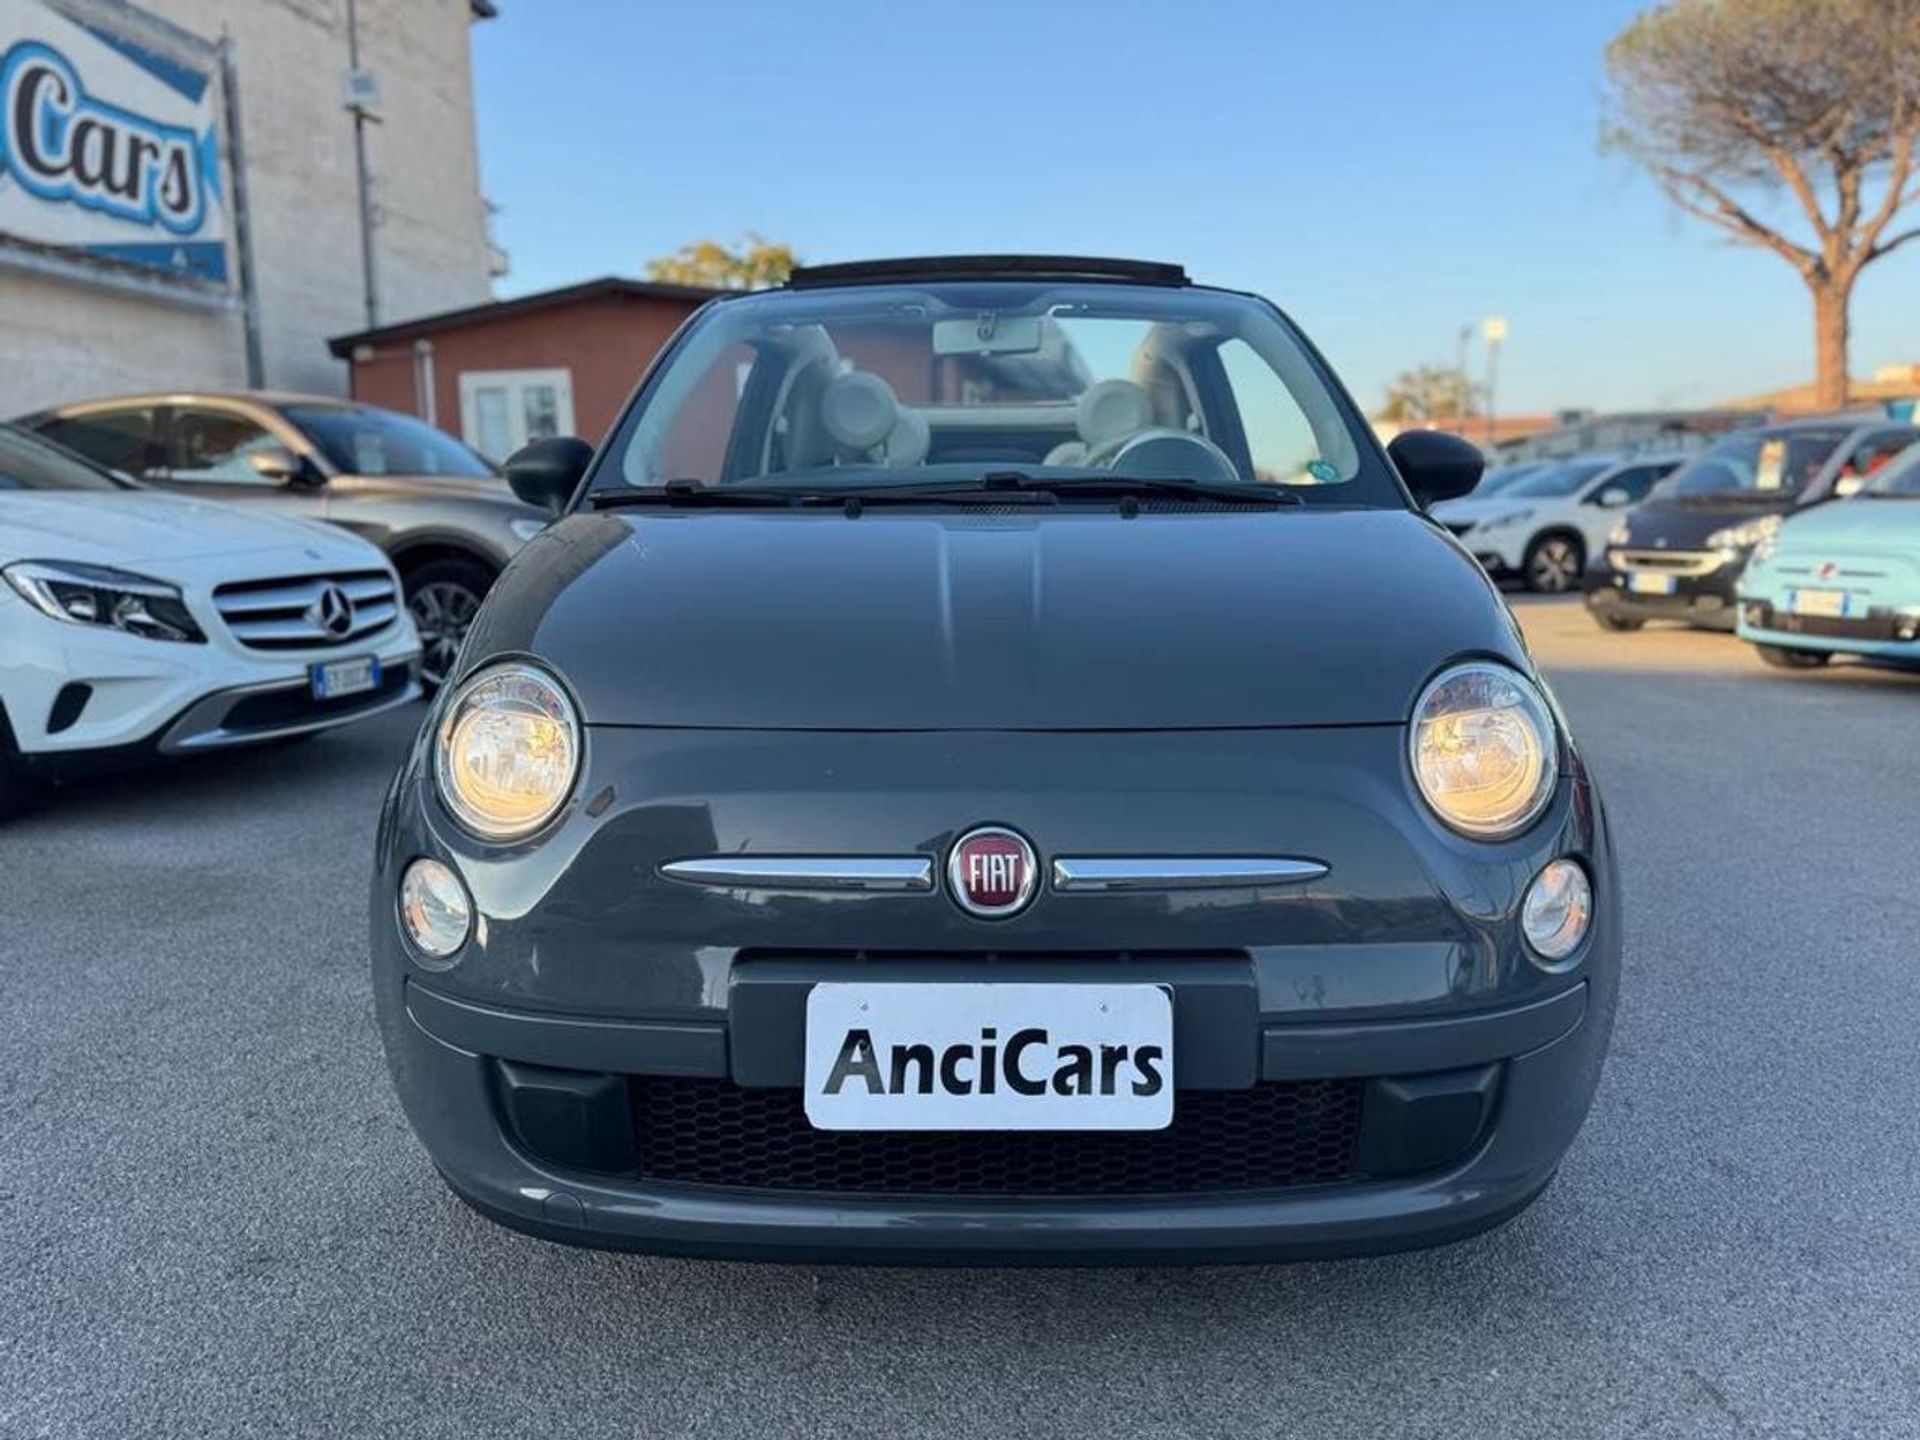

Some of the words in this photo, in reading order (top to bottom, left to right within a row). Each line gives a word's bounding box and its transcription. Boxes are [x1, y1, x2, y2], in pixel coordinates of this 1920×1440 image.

[15, 66, 190, 215] Cars
[969, 853, 1020, 893] FIAT
[822, 1028, 1163, 1097] AnciCars
